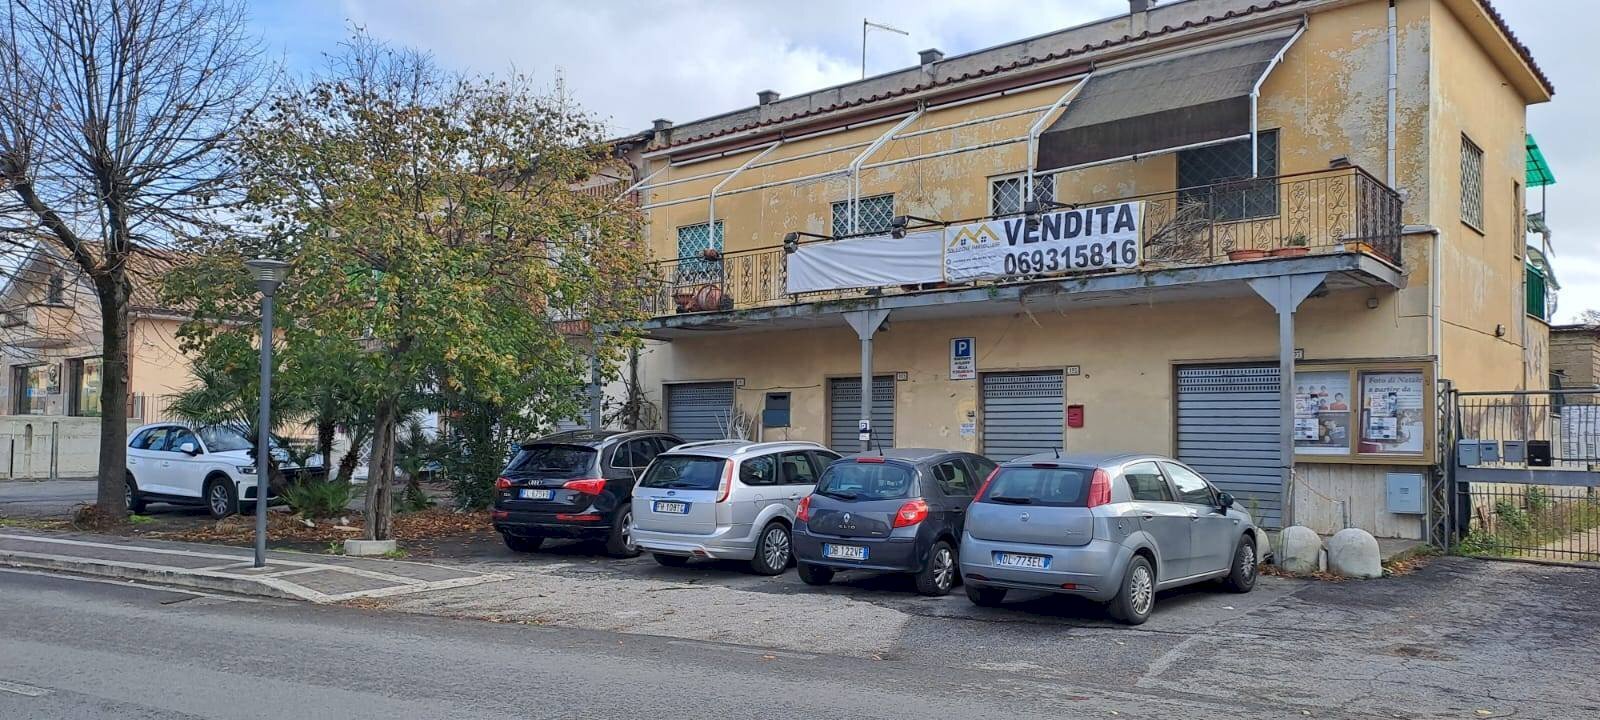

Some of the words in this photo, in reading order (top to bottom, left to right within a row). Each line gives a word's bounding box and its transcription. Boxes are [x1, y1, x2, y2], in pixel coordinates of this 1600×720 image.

[1004, 203, 1135, 246] VENDITA
[1004, 239, 1136, 274] 069315816
[958, 342, 967, 355] P
[1002, 554, 1012, 564] DL
[1015, 555, 1042, 568] 773EL
